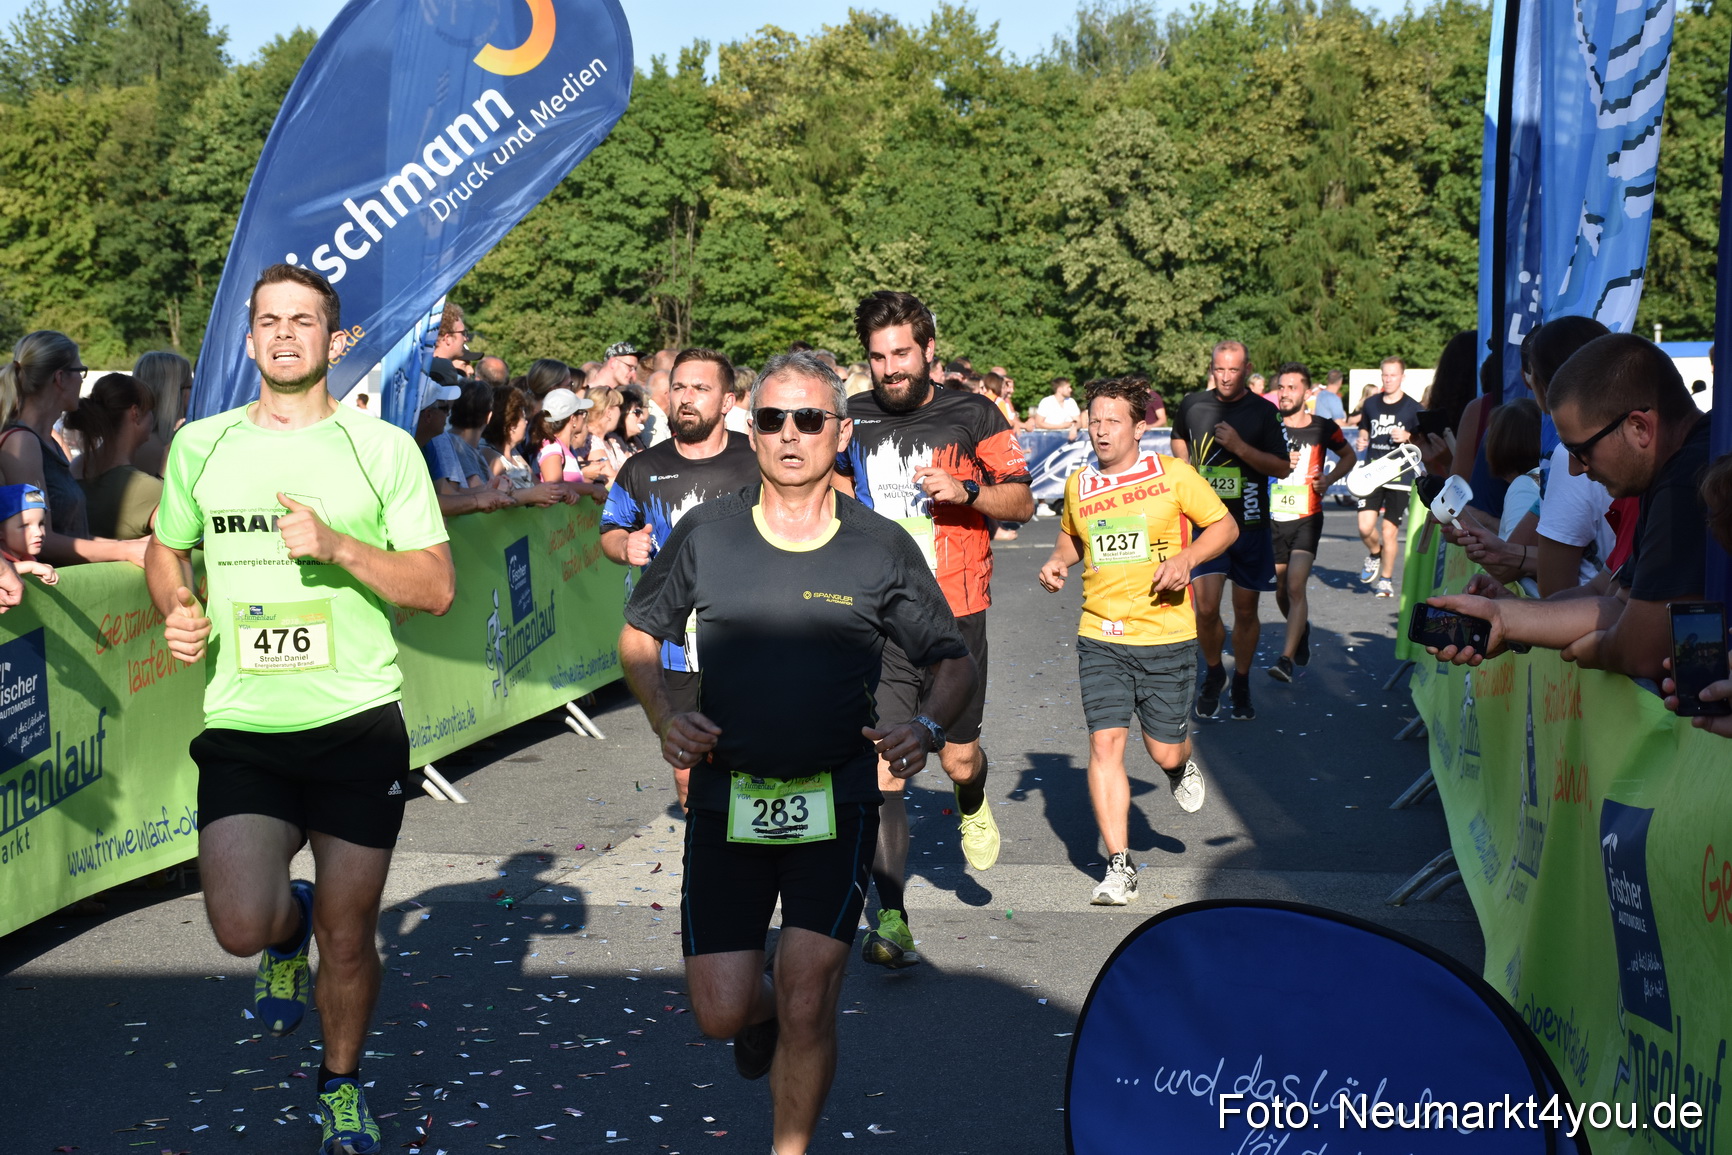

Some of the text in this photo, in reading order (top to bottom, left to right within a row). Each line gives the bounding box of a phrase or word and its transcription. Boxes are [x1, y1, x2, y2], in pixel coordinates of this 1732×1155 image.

[428, 58, 608, 222] Druck und Medien
[286, 88, 515, 285] schmann
[878, 483, 921, 491] AUTOHAUS
[884, 490, 915, 499] MÜLLER
[1206, 478, 1236, 490] 423
[1079, 482, 1171, 518] MAX BÖGL
[1281, 495, 1295, 506] 46
[211, 515, 284, 534] BRAN
[1096, 533, 1139, 552] 1237
[511, 564, 527, 582] Fischer
[813, 592, 853, 602] SPANGLER
[253, 627, 311, 655] 476
[505, 589, 556, 670] firmenlauf
[284, 654, 309, 662] Daniel
[0, 674, 38, 707] ischer
[0, 706, 107, 830] menlauf
[751, 795, 809, 827] 283
[2, 827, 30, 864] arkt
[67, 805, 198, 877] www.firmenlauf-ob
[1608, 867, 1643, 910] Fischer
[1618, 910, 1647, 933] AUTOMOBILE
[1154, 1057, 1225, 1106] und
[1233, 1054, 1301, 1110] das
